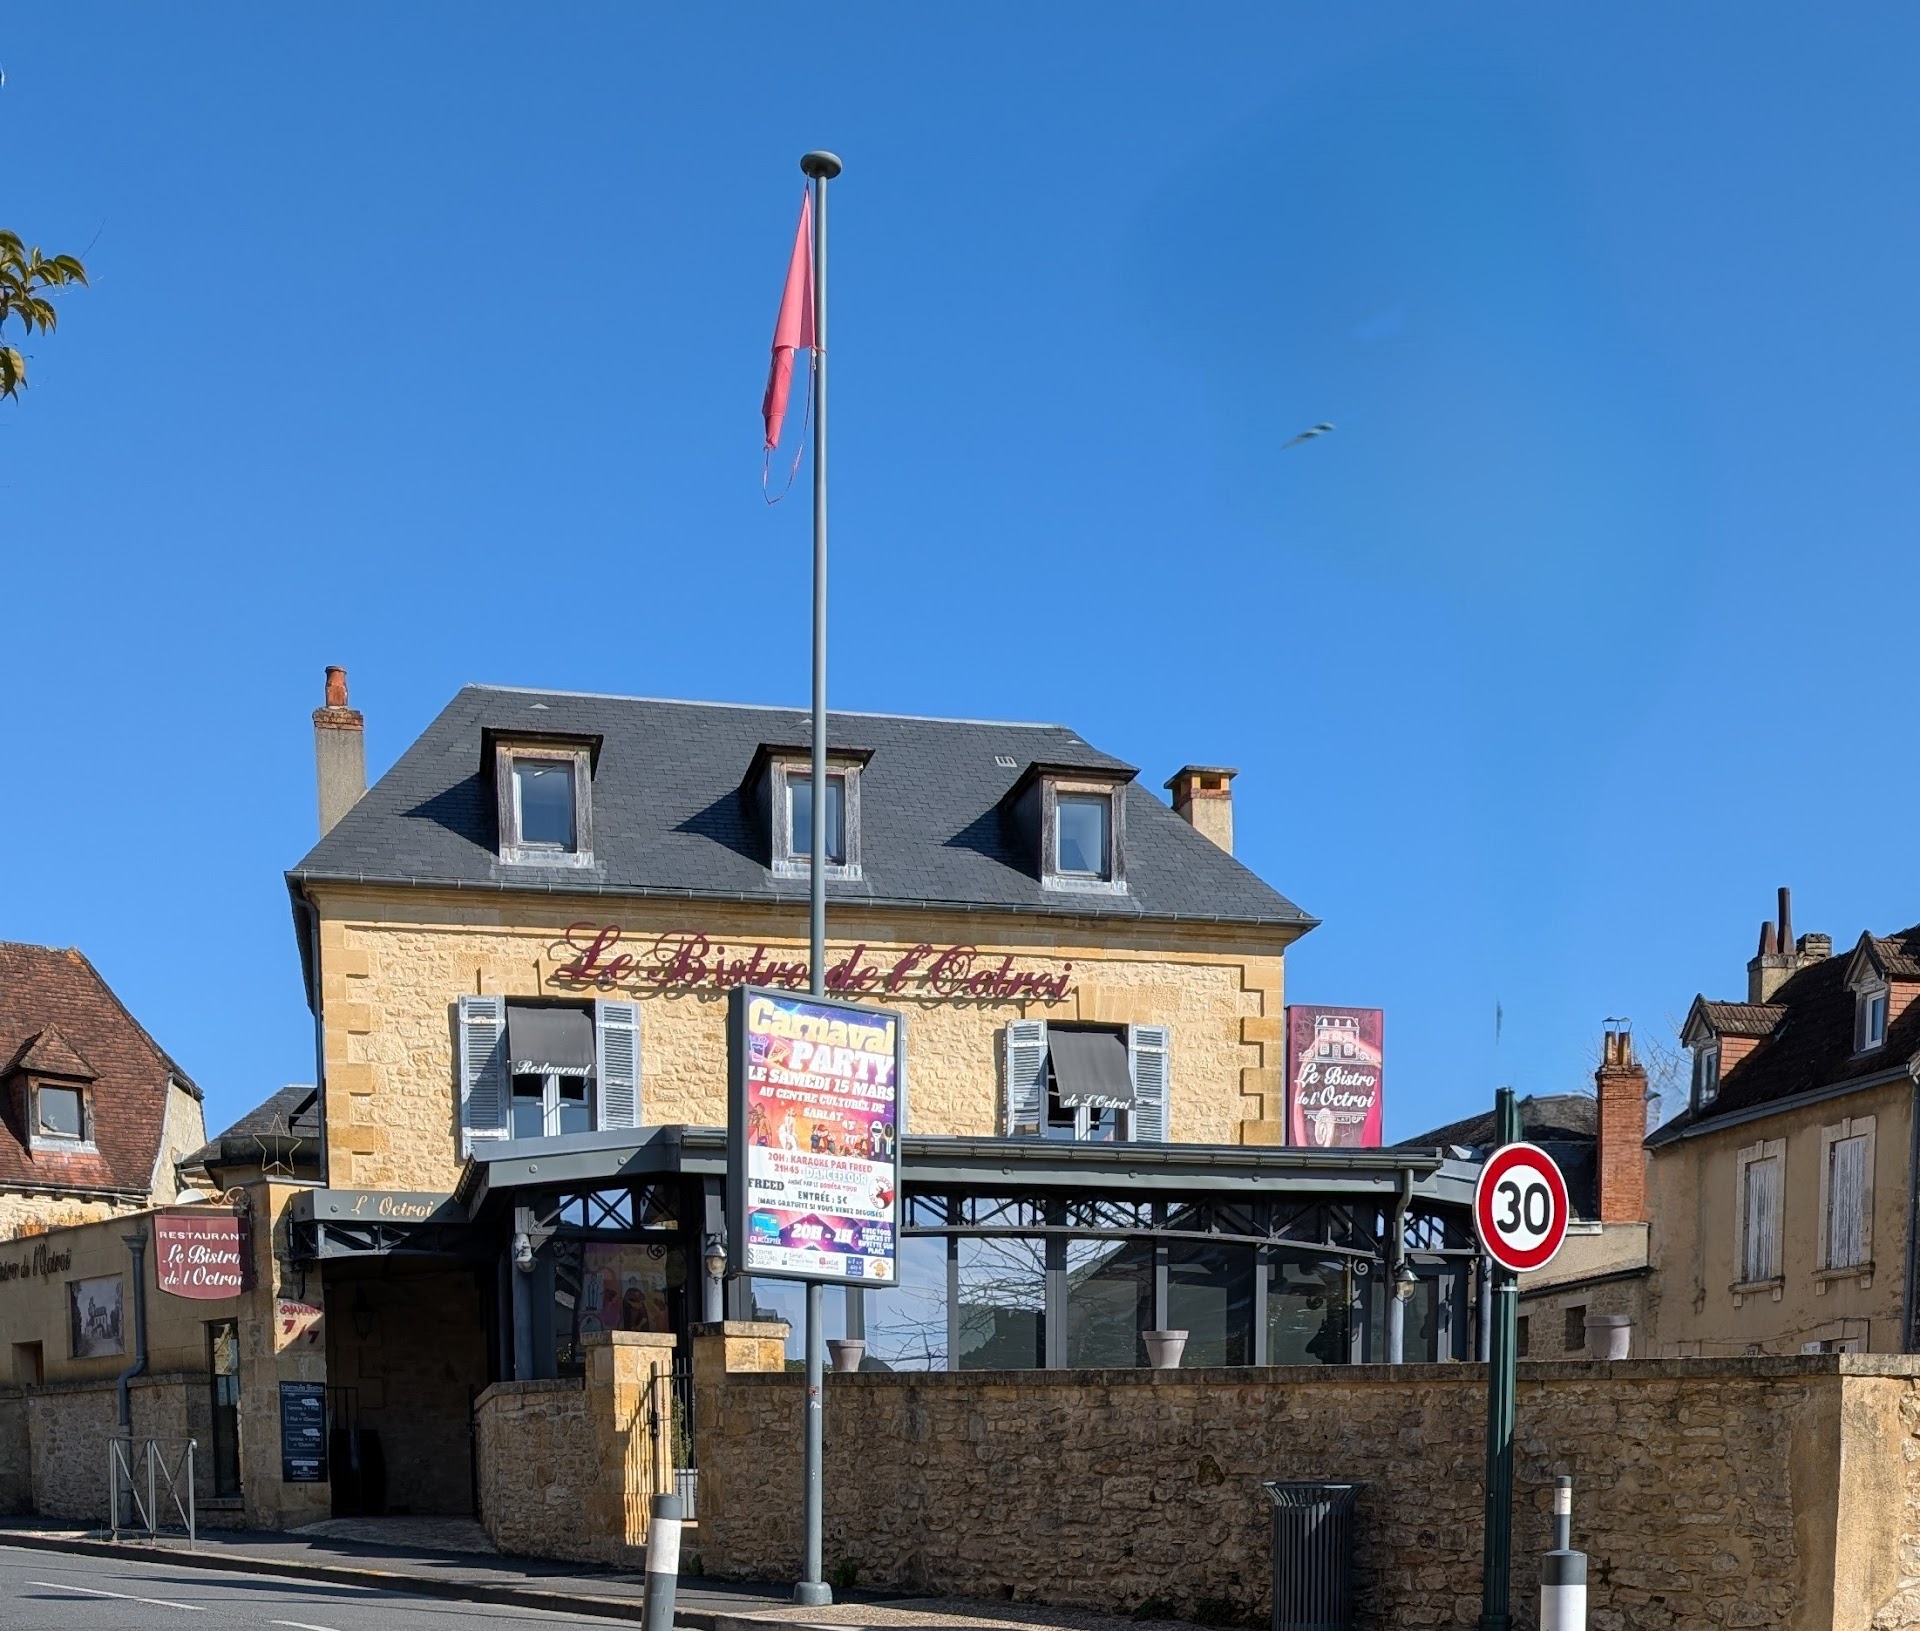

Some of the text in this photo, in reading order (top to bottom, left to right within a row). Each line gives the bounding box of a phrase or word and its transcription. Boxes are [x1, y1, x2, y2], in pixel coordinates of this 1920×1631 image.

[555, 921, 632, 980] Le
[645, 930, 810, 988] Bistro
[823, 943, 878, 991] de
[748, 998, 895, 1055] Carnaval
[516, 1060, 592, 1075] Restaurant
[788, 1040, 895, 1084] PARTY
[748, 1066, 895, 1101] LE SAMEDI 15 MARS
[1294, 1063, 1377, 1088] Le Bistro
[759, 1086, 774, 1098] AU
[776, 1089, 819, 1103] CENTRE
[871, 1102, 886, 1114] DE
[1064, 1094, 1079, 1107] de
[1296, 1091, 1309, 1105] de
[803, 1107, 844, 1121] SARLAT
[768, 1152, 785, 1162] 20H
[831, 1160, 848, 1170] PAR
[849, 1162, 873, 1173] FREED
[748, 1178, 785, 1191] FREED
[805, 1166, 868, 1185] DANCEFLOOR
[798, 1190, 831, 1203] ENTRÉE
[1496, 1180, 1550, 1235] 30
[159, 1231, 248, 1241] RESTAURANT
[162, 1243, 241, 1268] Le Bistro
